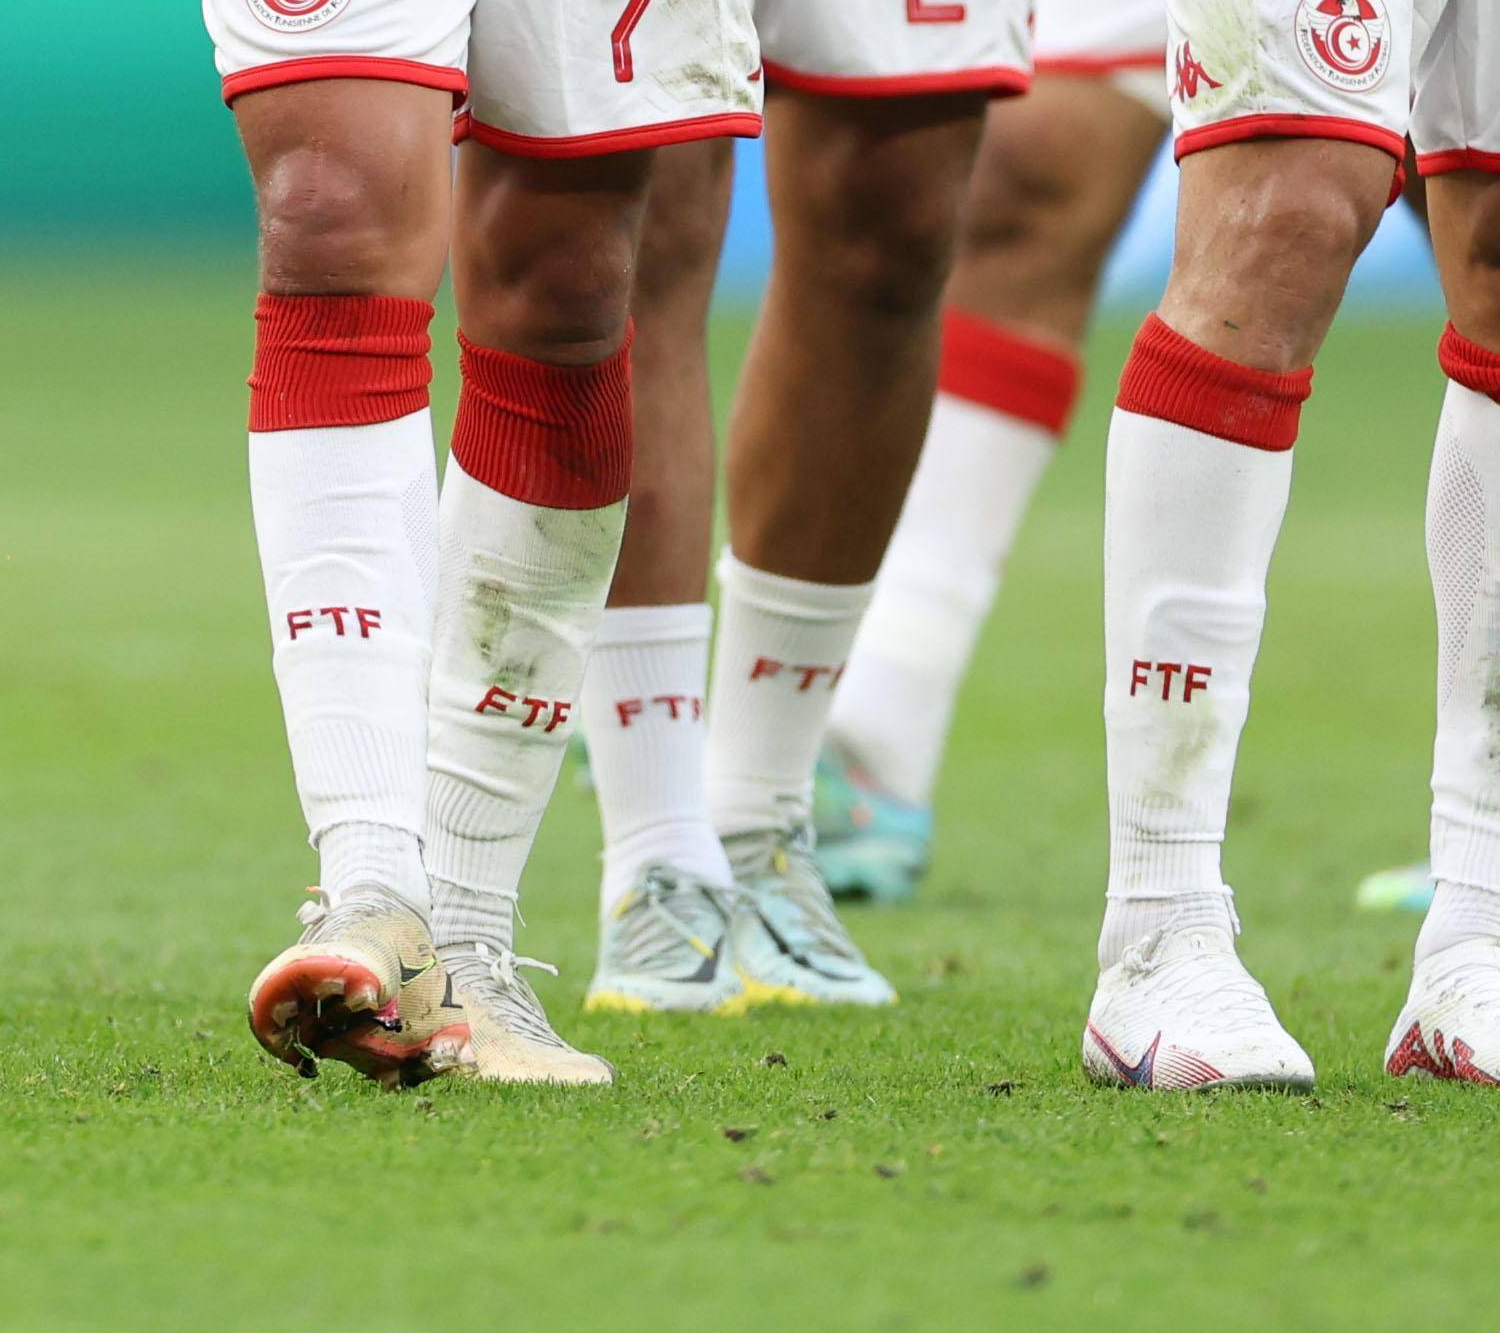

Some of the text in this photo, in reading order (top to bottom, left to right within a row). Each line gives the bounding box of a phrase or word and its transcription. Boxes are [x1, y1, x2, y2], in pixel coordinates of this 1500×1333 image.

[287, 606, 382, 641] FTF
[1130, 659, 1213, 704] FTF
[475, 684, 572, 733] FTF
